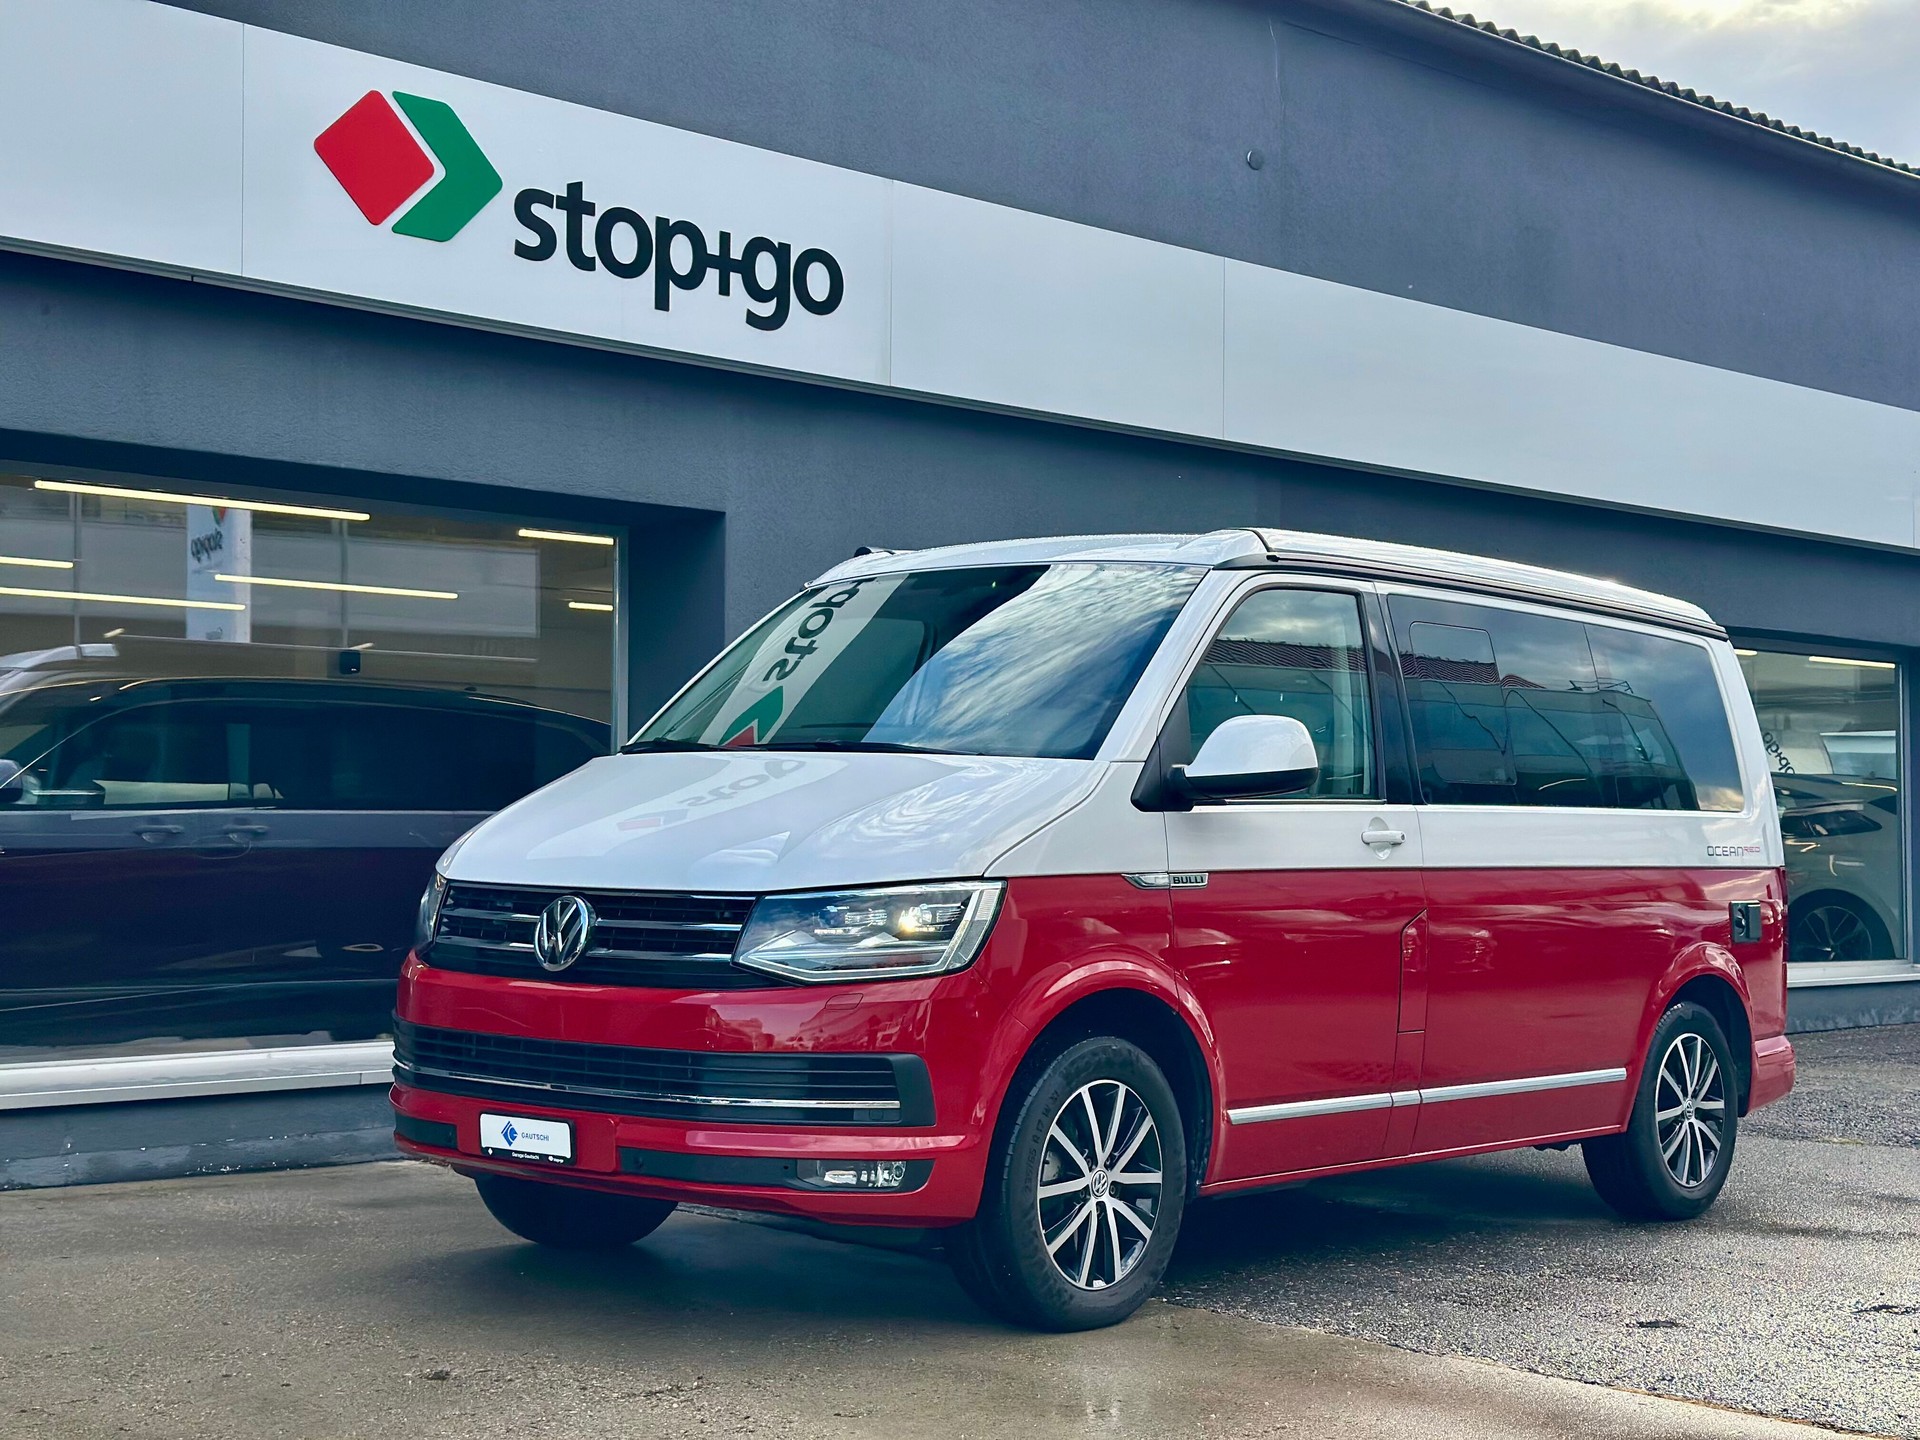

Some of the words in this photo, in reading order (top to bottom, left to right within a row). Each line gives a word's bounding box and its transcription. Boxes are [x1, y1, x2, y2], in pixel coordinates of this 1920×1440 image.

[514, 181, 844, 331] stop+go
[1173, 876, 1203, 884] BULLI
[521, 1132, 550, 1142] GAUTSCHI
